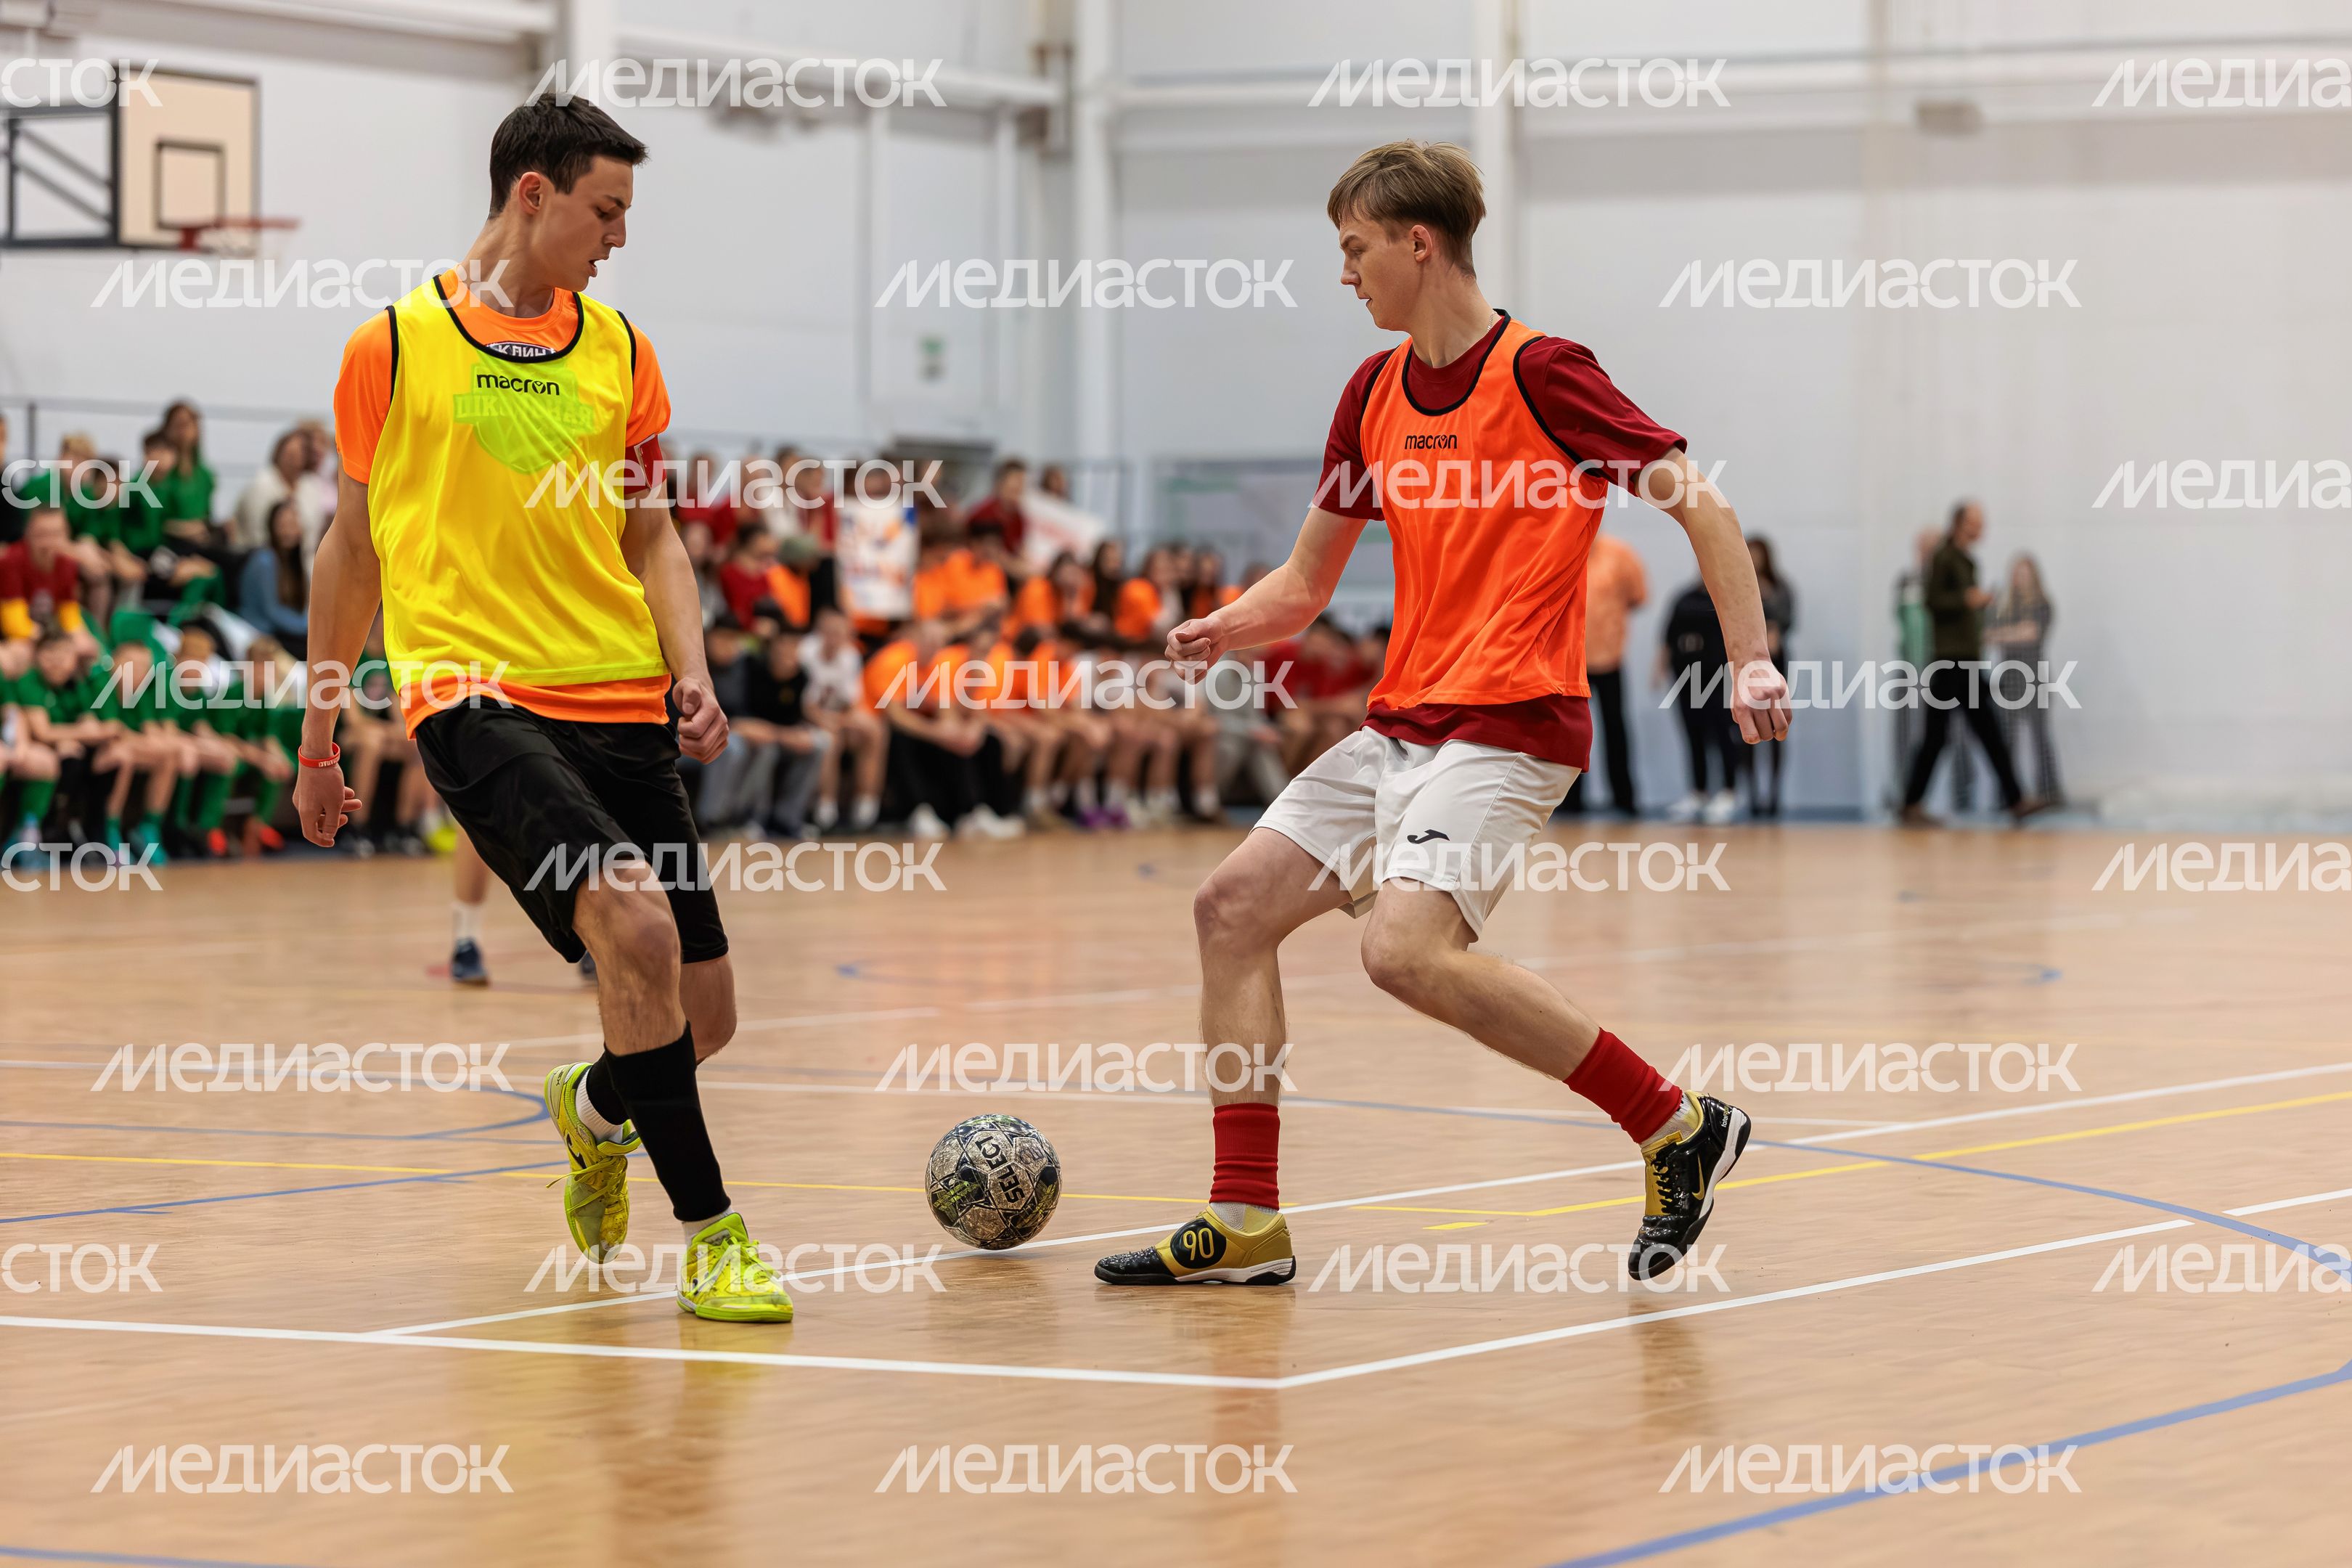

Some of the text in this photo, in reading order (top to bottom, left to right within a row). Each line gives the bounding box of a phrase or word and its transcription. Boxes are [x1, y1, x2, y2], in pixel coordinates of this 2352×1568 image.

[476, 374, 560, 396] macron
[1405, 434, 1457, 449] macron
[975, 1135, 1026, 1204] SELECT
[1183, 1228, 1214, 1261] 90
